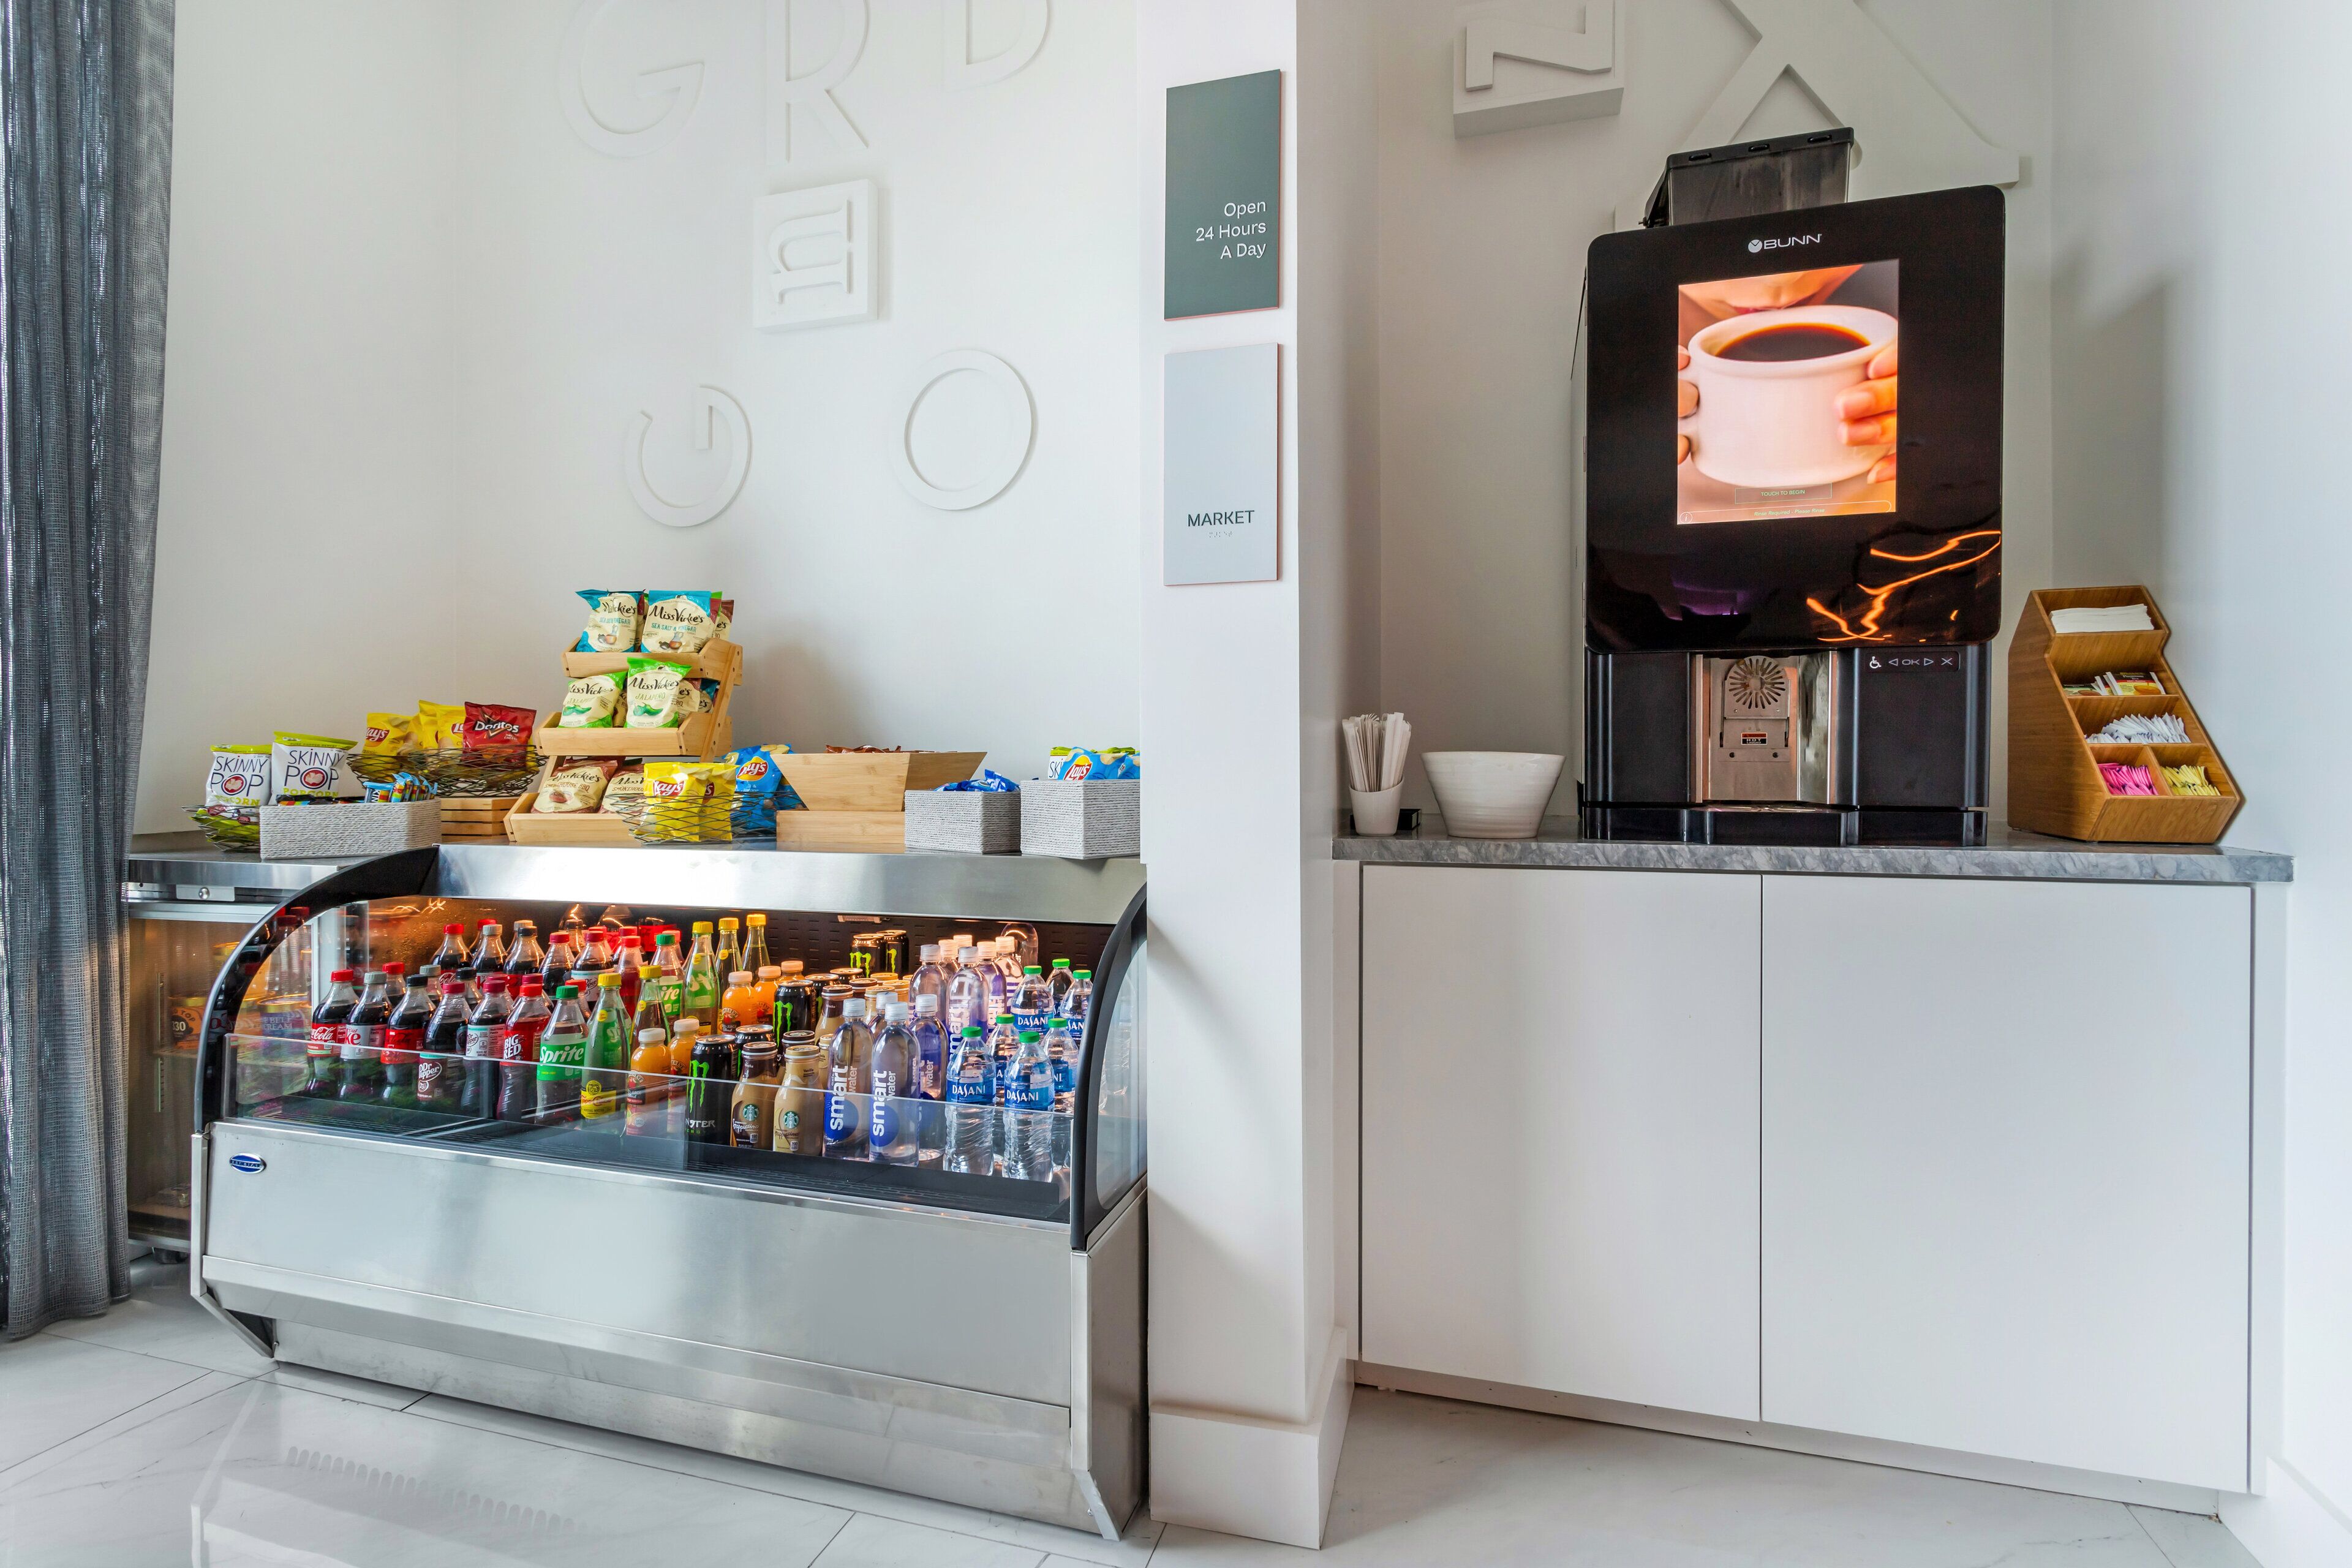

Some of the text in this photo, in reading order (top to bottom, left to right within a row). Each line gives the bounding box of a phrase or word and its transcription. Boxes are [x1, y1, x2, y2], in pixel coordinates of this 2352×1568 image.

[1224, 201, 1266, 219] Open
[1196, 222, 1267, 242] 24 Hours
[1764, 234, 1822, 249] BUNN
[1220, 243, 1267, 260] A Day
[1188, 510, 1255, 527] MARKET
[649, 605, 674, 621] Miss
[628, 677, 653, 690] Miss
[475, 721, 519, 733] Doritos
[211, 772, 264, 797] POP
[284, 766, 339, 790] POP
[579, 783, 590, 793] BBQ
[1017, 1016, 1049, 1028] DASANI
[505, 1034, 519, 1049] BIG
[503, 1044, 522, 1060] RED
[540, 1046, 584, 1066] Sprite
[830, 1065, 848, 1131] smart
[952, 1084, 986, 1097] DASANI
[1006, 1088, 1039, 1103] DASANI
[872, 1070, 887, 1137] smart
